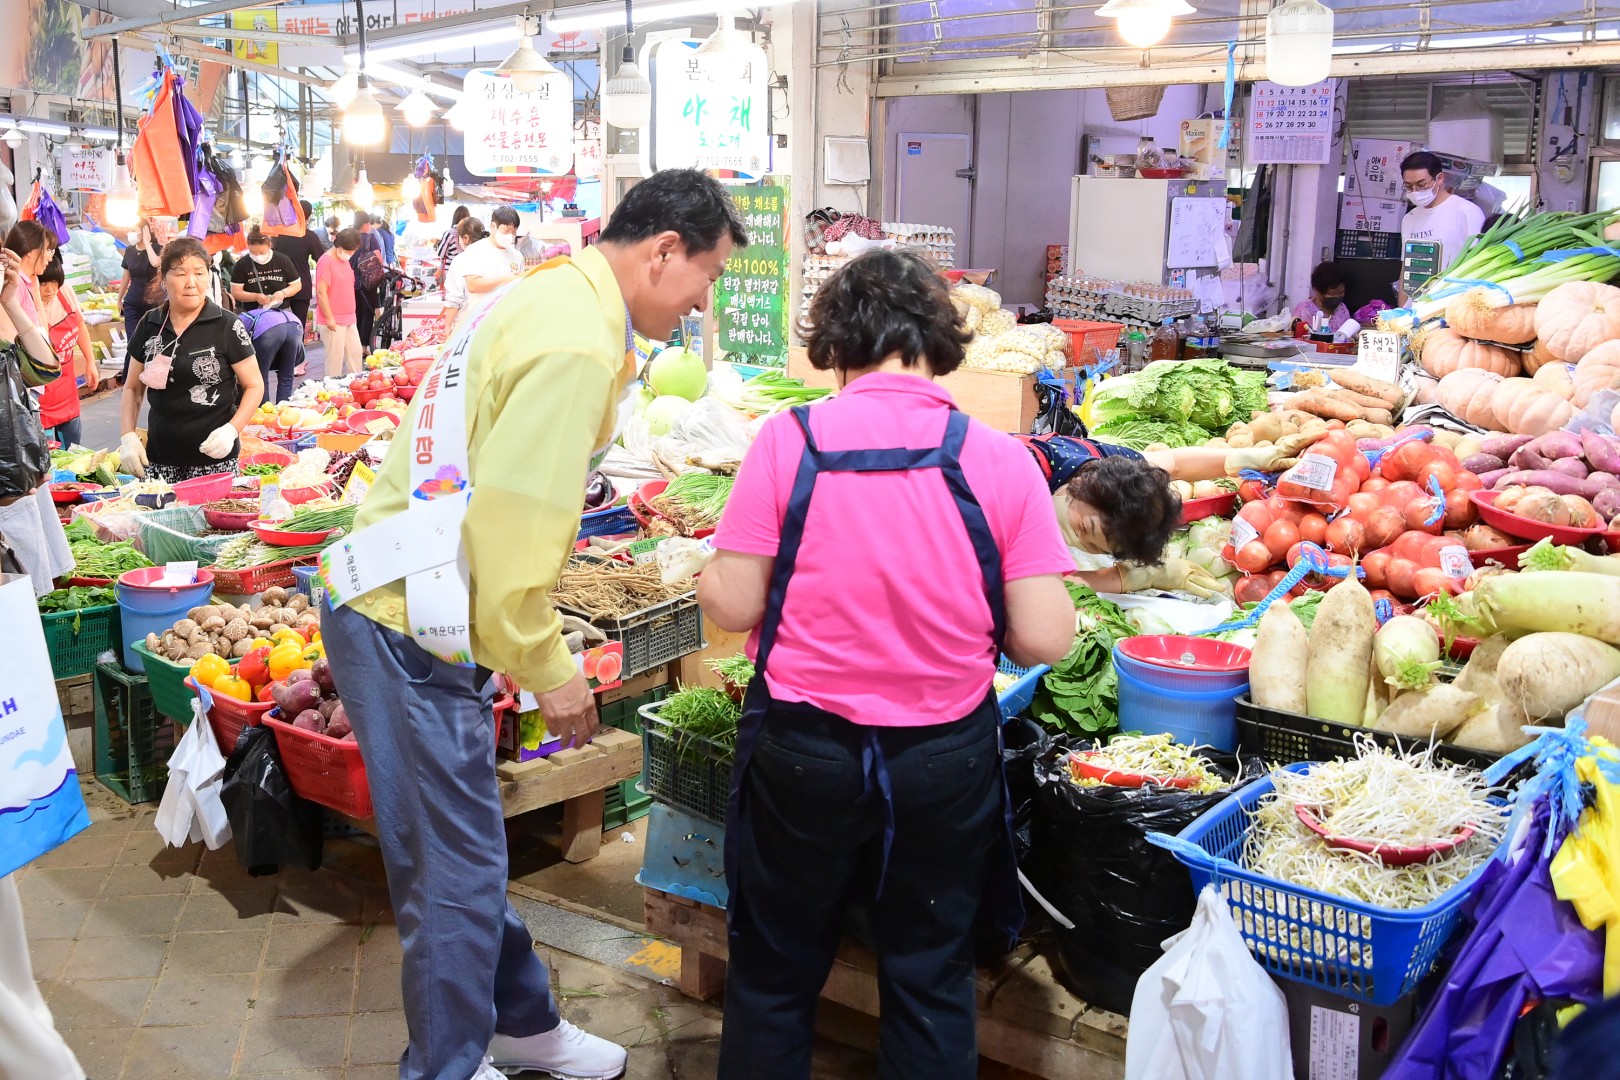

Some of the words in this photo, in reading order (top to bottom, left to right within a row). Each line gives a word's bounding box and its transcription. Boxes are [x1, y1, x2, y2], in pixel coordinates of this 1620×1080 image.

[483, 82, 550, 101] 싱싱일
[1259, 88, 1264, 96] 4
[1269, 88, 1274, 96] 5
[483, 130, 548, 149] 선물용전문
[754, 195, 778, 211] 채소를
[745, 212, 780, 229] 재배해서
[1355, 220, 1381, 231] 종이컵
[725, 257, 779, 275] 국산100%
[724, 276, 741, 292] 된장
[744, 278, 779, 295] 멸치젓갈
[731, 311, 748, 327] 직접
[752, 313, 770, 328] 담아
[728, 328, 775, 347] 판매합니다.
[346, 555, 361, 593] 해운대구
[428, 625, 466, 637] 해운대구
